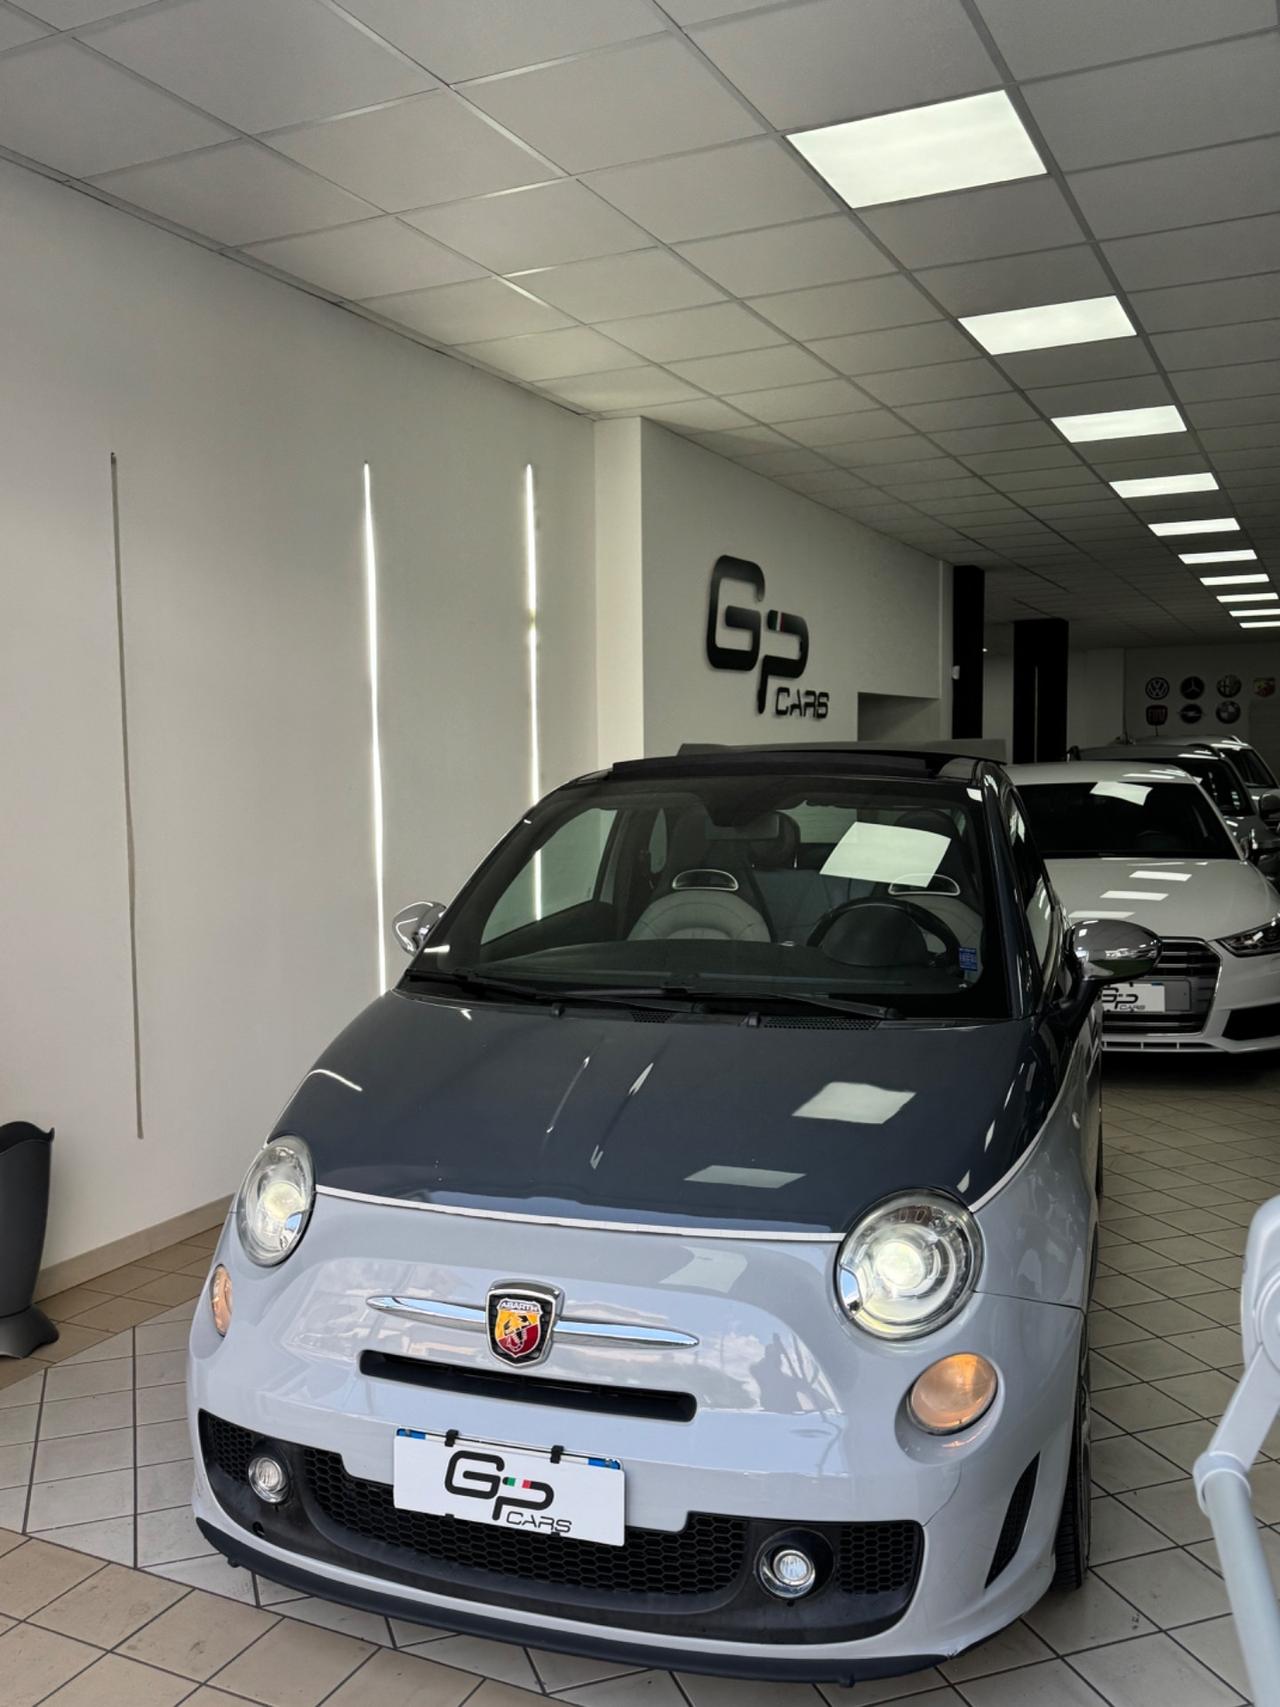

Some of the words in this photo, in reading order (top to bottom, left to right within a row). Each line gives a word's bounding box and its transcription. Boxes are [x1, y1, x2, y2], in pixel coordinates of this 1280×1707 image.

[707, 555, 809, 714] GP
[774, 686, 830, 719] CARS
[445, 1450, 555, 1521] GP
[506, 1510, 573, 1533] CARS
